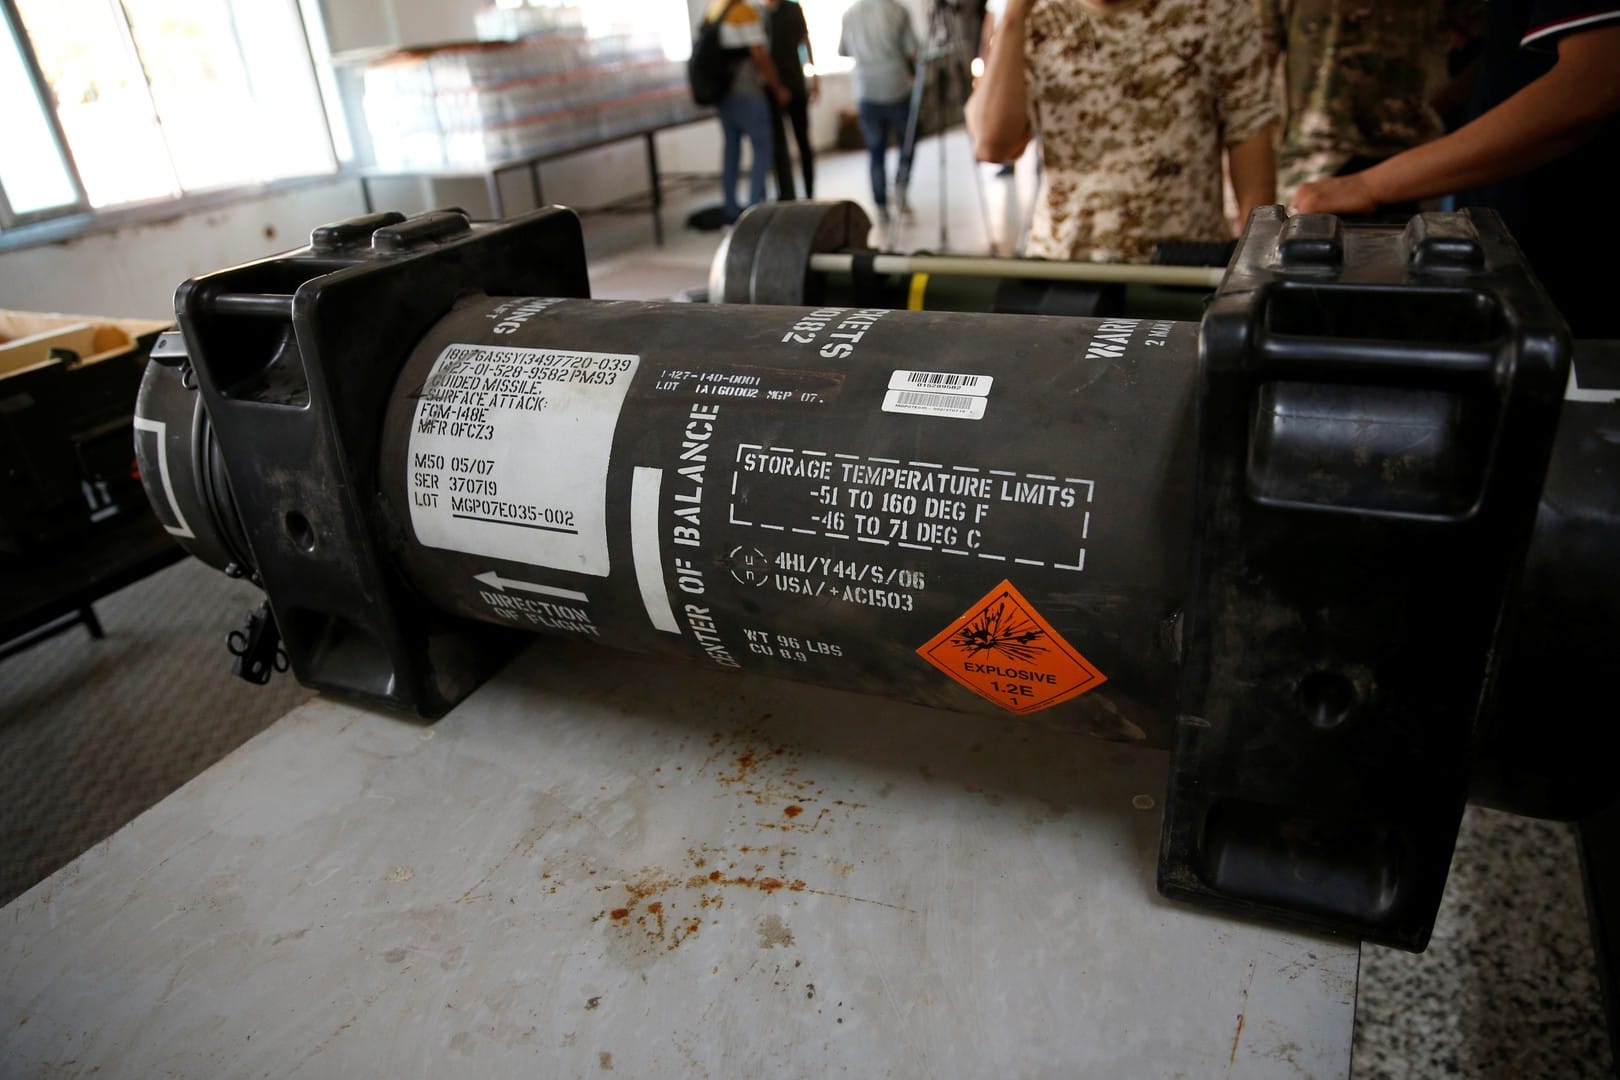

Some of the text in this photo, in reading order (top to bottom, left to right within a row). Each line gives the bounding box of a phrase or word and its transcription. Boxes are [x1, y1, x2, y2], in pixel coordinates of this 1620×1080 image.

[432, 375, 480, 391] GUIDED
[569, 369, 617, 385] PM93
[655, 381, 679, 391] LOT
[425, 388, 485, 407] SURFACE
[420, 402, 490, 423] FGM-148E
[417, 418, 447, 434] MFR
[450, 457, 495, 475] 05/07
[414, 473, 497, 496] SER 370719
[743, 452, 1076, 508] STORAGE TEMPERATURE LIMITS
[414, 491, 574, 526] LOT MGP07E035-002
[810, 485, 990, 524] -51 TO 160 DEG F
[673, 403, 741, 668] CENTER OF BALANCE
[811, 511, 982, 549] -46 TO 71 DEG C
[479, 590, 591, 623] DIRECTION
[493, 607, 600, 636] OF FLIGHT
[743, 629, 843, 657] WT 96 LBS
[749, 643, 774, 656] CU
[964, 661, 1057, 684] EXPLOSIVE
[990, 681, 1034, 698] 1.2E
[1010, 697, 1018, 705] 1
